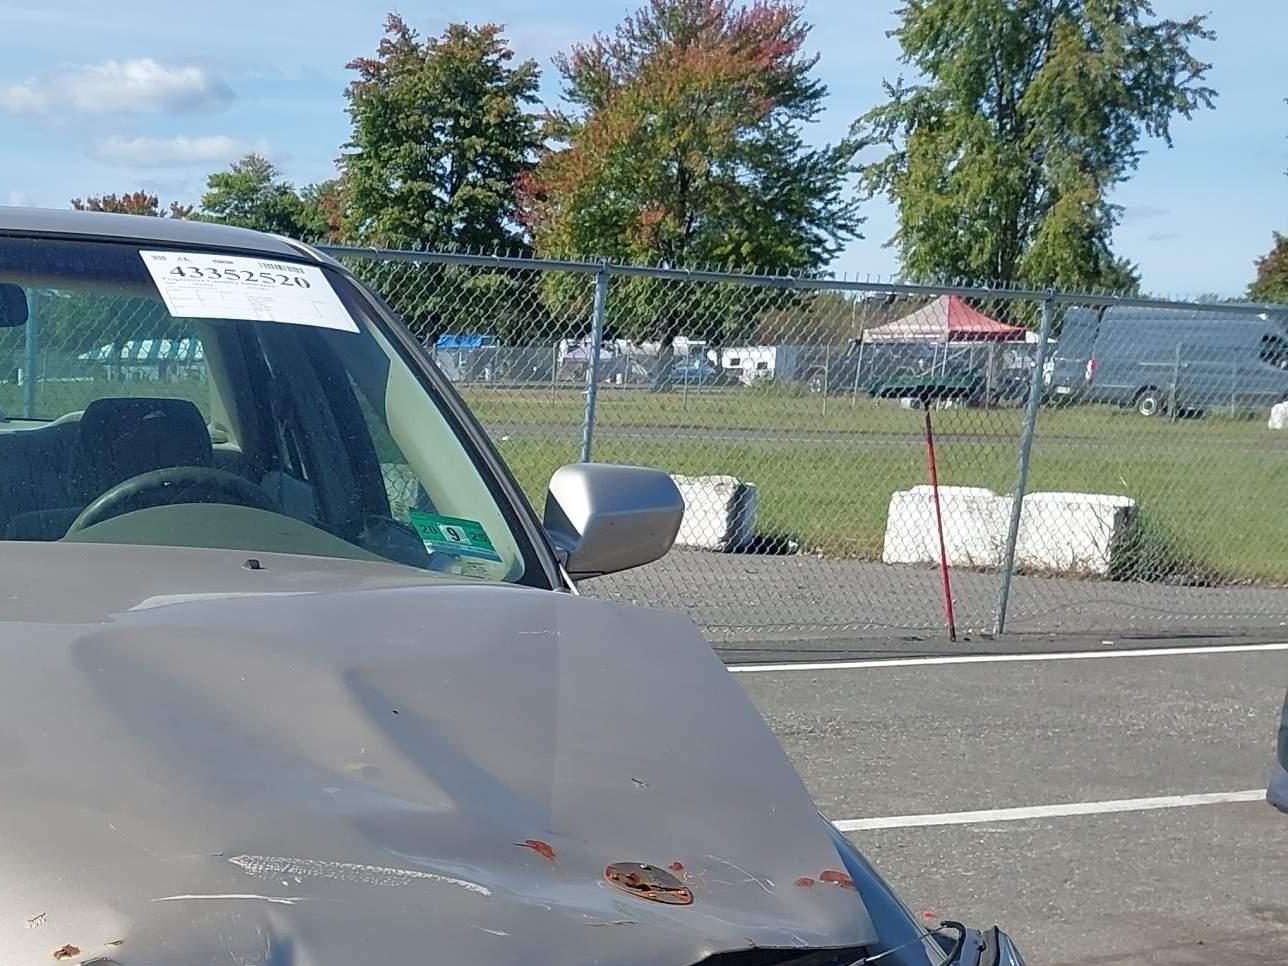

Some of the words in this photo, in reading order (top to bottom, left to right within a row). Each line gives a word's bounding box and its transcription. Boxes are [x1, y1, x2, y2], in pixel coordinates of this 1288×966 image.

[169, 265, 311, 289] 43352520
[421, 524, 437, 535] 20
[446, 527, 461, 542] 9
